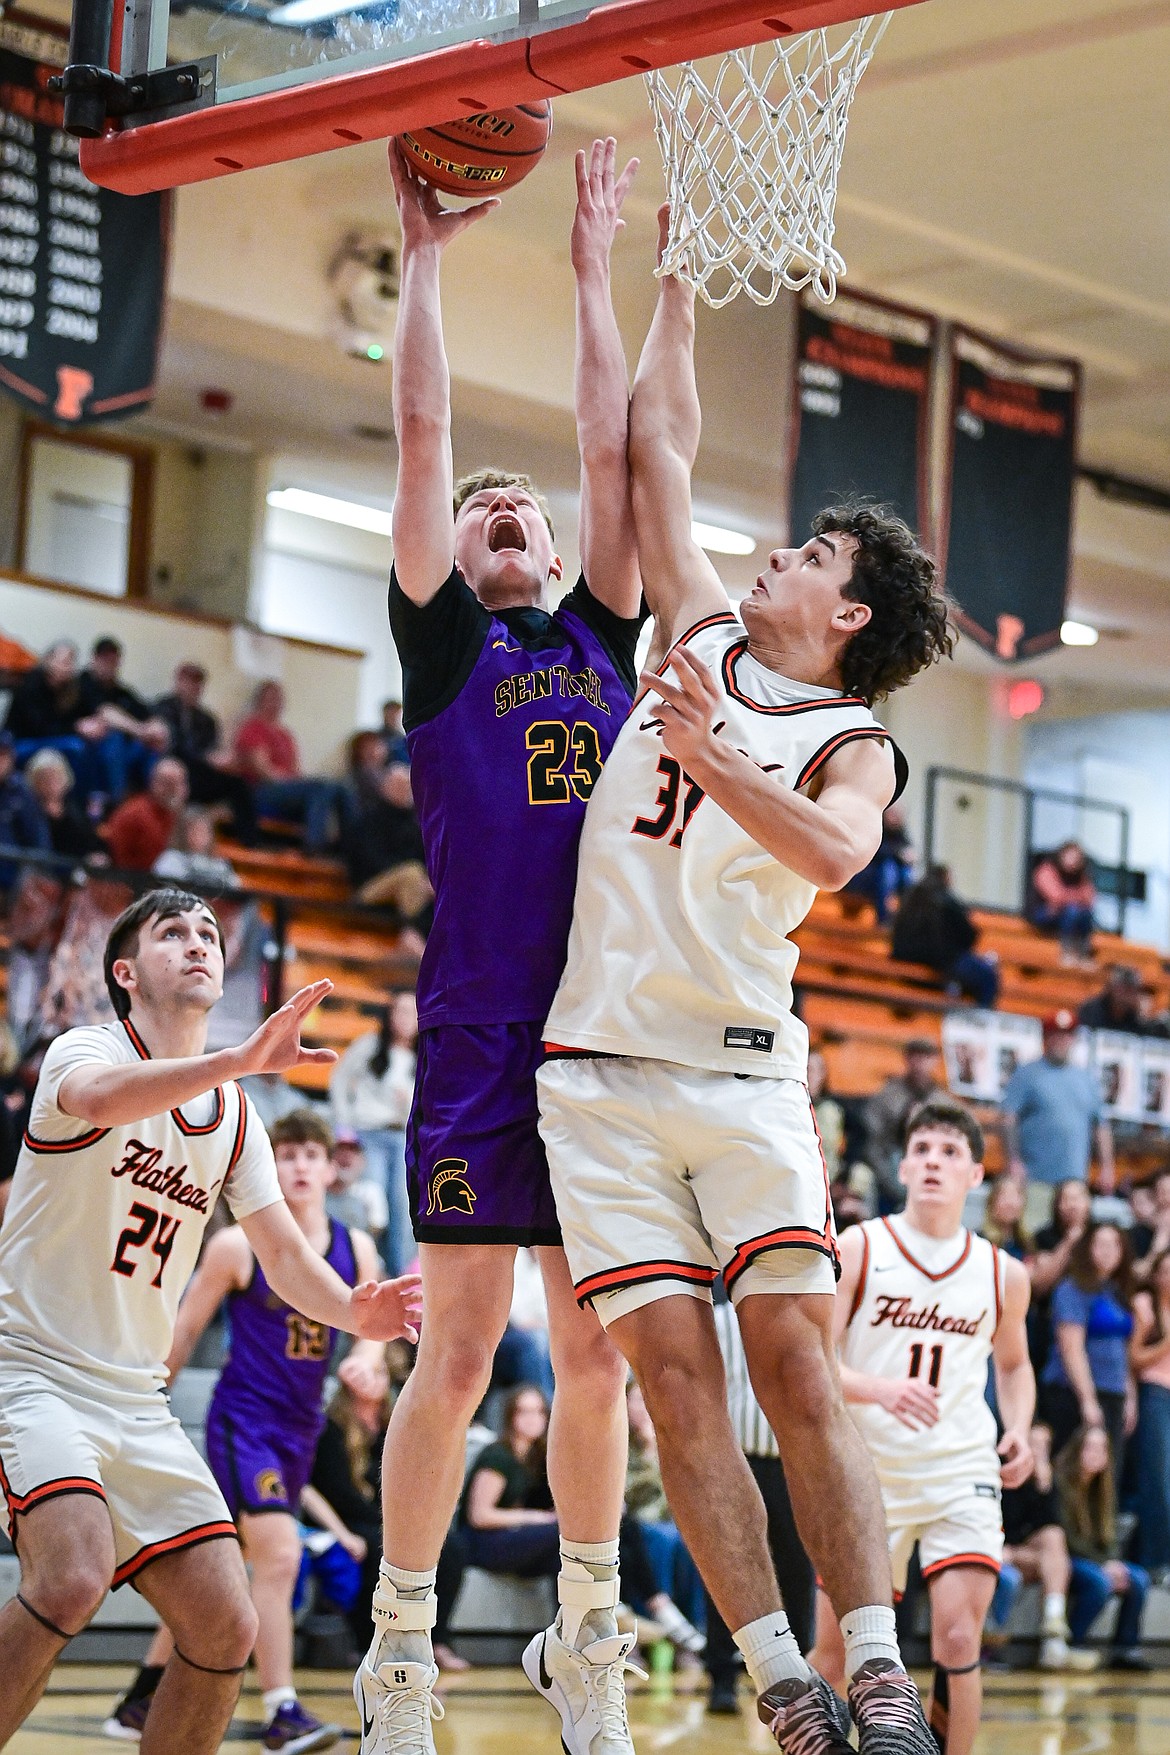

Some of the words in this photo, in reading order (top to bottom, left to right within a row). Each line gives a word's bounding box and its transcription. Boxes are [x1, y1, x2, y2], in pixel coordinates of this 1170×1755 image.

[402, 132, 466, 179] ELITE
[468, 166, 504, 181] PRO
[525, 720, 604, 805] 23
[755, 1034, 769, 1046] XL
[110, 1200, 183, 1289] 24
[870, 1294, 988, 1337] Flathead
[908, 1342, 943, 1389] 11
